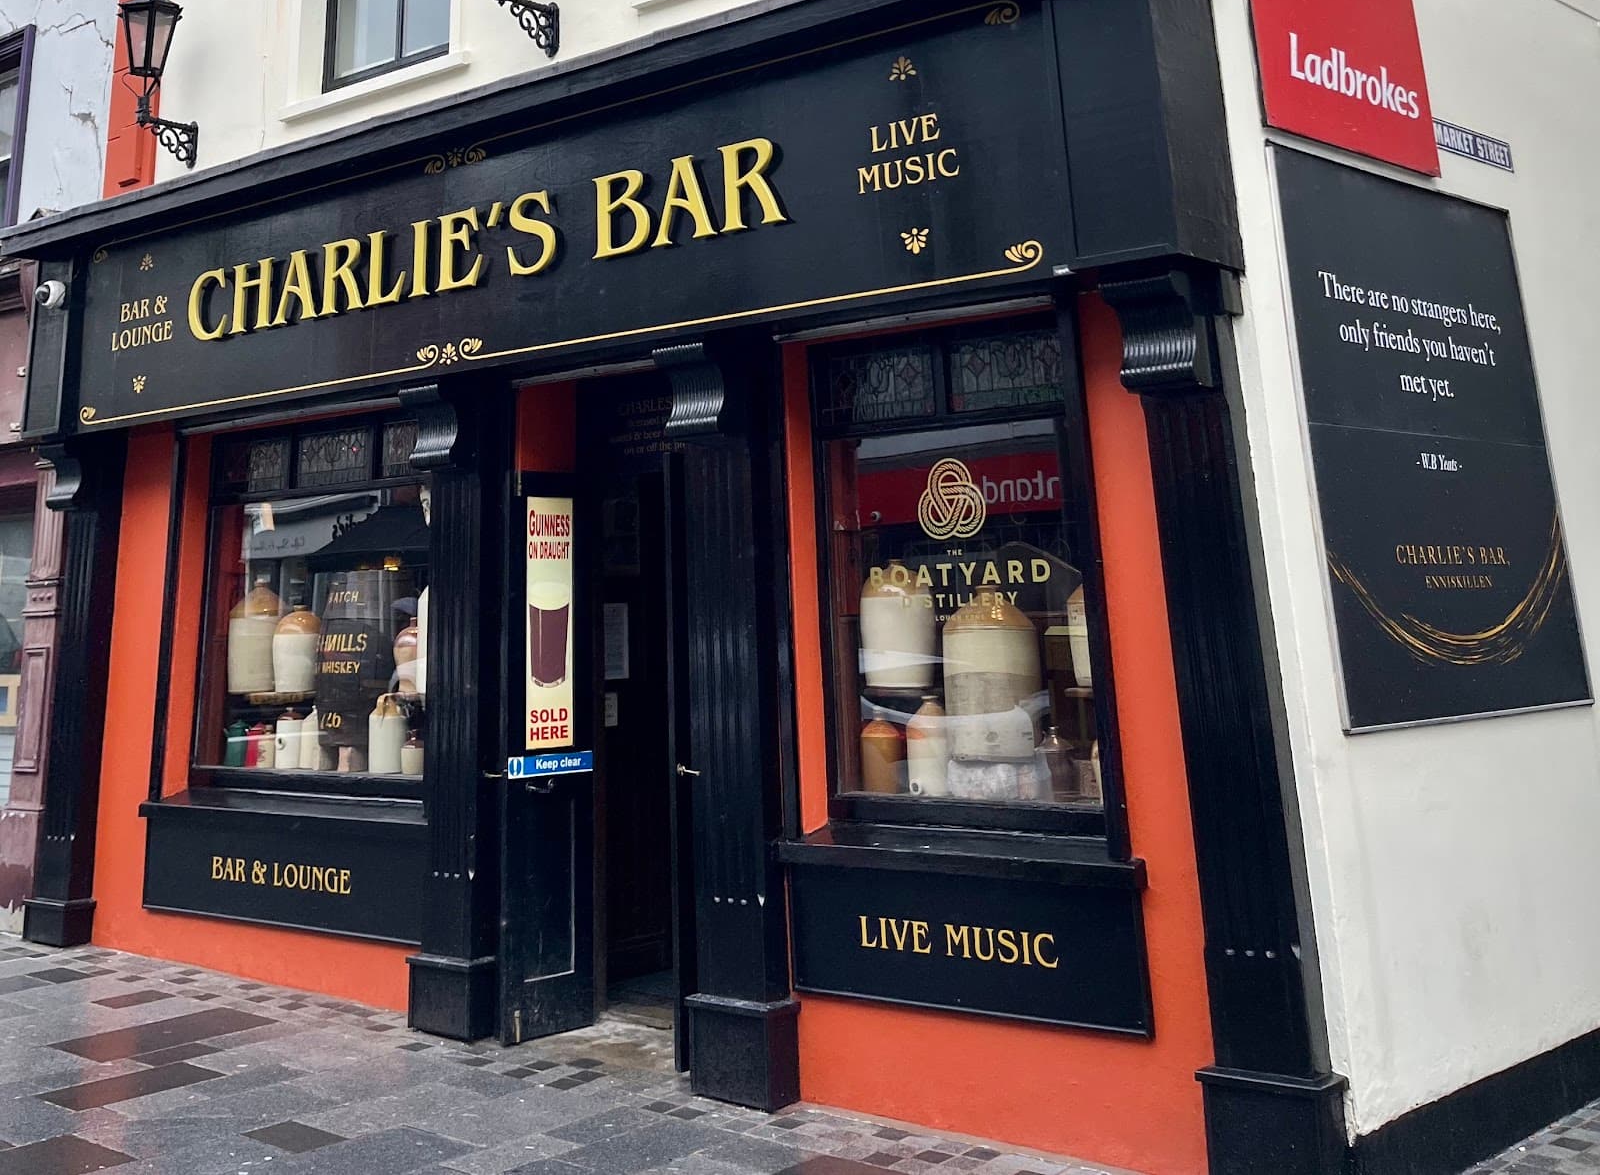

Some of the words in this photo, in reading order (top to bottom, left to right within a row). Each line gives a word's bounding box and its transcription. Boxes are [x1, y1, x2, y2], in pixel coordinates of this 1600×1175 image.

[1288, 32, 1420, 119] Ladbrokes
[870, 112, 940, 153] LIVE
[1436, 122, 1474, 155] MARKET
[1476, 137, 1509, 167] STREET
[857, 148, 960, 194] MUSIC
[187, 190, 557, 341] CHARLIE'S
[592, 137, 787, 260] BAR
[120, 299, 150, 323] BAR
[153, 295, 167, 316] &
[1318, 271, 1365, 304] There
[1368, 289, 1389, 309] are
[1392, 295, 1409, 313] no
[1412, 298, 1467, 327] strangers
[1469, 304, 1501, 334] here,
[111, 320, 173, 352] LOUNGE
[1340, 319, 1369, 351] only
[1373, 322, 1420, 353] friends
[1422, 337, 1447, 361] you
[1449, 337, 1496, 366] haven't
[1400, 374, 1427, 394] met
[1429, 378, 1454, 401] yet.
[1438, 454, 1458, 472] Yeats
[529, 509, 570, 537] GUINNESS
[529, 541, 538, 560] ON
[540, 541, 570, 560] DRAUGHT
[1396, 544, 1475, 565] CHARLIE'S
[869, 558, 1051, 588] BOATYARD
[1425, 575, 1493, 589] ENNISKILLEN
[902, 591, 1018, 610] DSTILLERY
[322, 661, 361, 675] WHISKEY
[530, 708, 568, 724] SOLD
[530, 725, 569, 741] HERE
[535, 758, 558, 771] Keep
[560, 756, 581, 768] clear
[211, 856, 246, 882] BAR
[251, 860, 267, 885] &
[273, 863, 352, 894] LOUNGE
[859, 915, 932, 954] LIVE
[944, 923, 1059, 968] MUSIC
